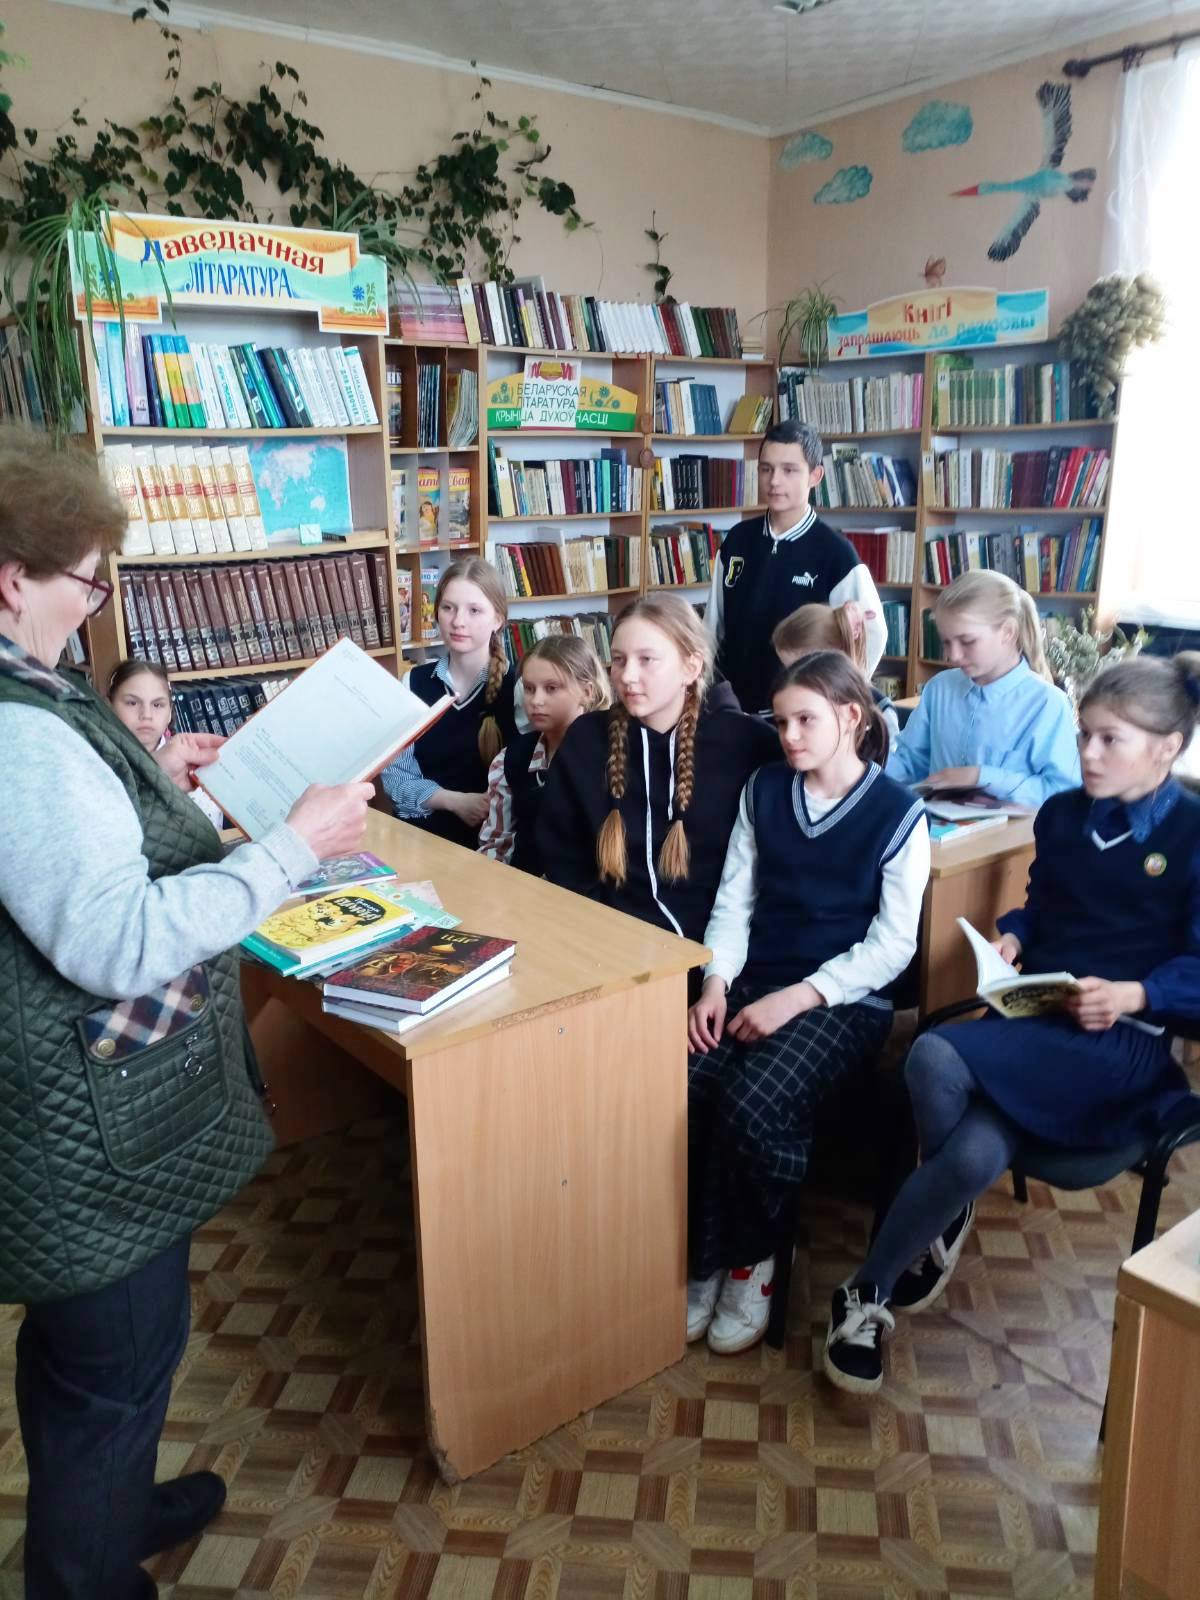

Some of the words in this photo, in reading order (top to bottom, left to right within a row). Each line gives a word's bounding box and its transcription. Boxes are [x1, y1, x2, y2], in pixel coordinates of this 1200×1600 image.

[141, 229, 324, 275] Даведачная
[186, 257, 294, 299] ЛІТАРАТУРА
[903, 296, 953, 324] Кнігі
[836, 327, 921, 357] запрашаюць
[928, 325, 949, 339] да
[516, 383, 587, 398] БЕЛАРУСКАЯ
[516, 396, 577, 410] ЛІТАРАТУРА
[495, 409, 535, 423] КРЫНІЦА
[539, 410, 609, 426] ДУХОЎНАСЦІ
